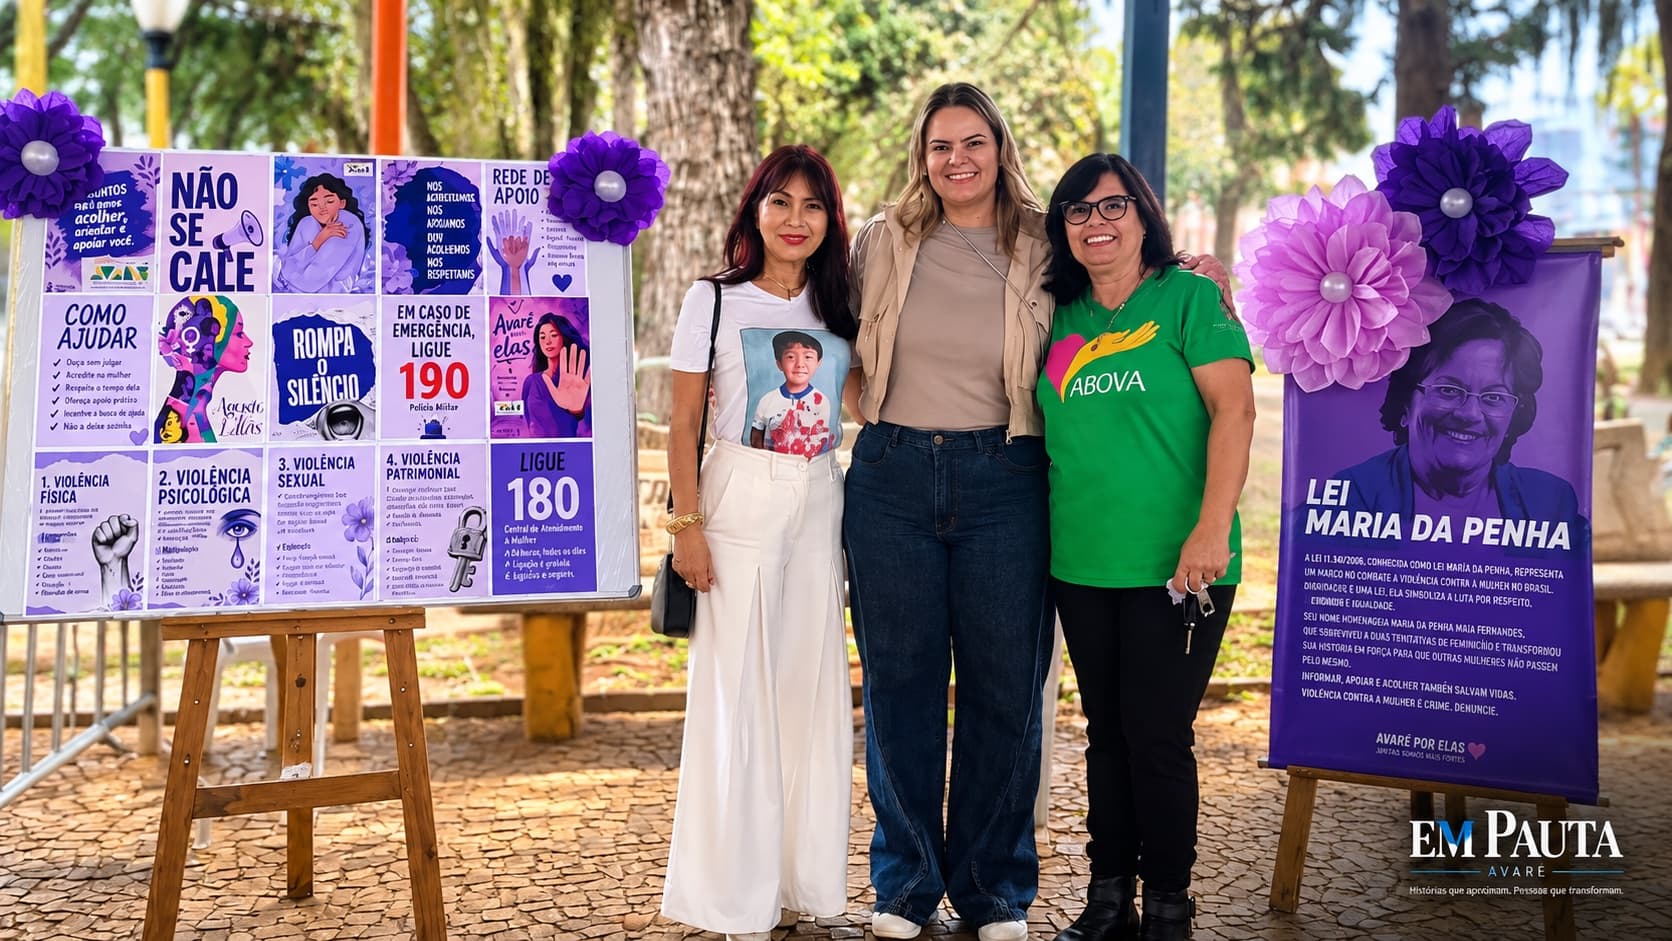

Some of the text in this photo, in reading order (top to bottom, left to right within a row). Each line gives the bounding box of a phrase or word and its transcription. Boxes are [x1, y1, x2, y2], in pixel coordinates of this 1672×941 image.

[427, 181, 443, 192] NOS
[493, 168, 550, 185] REDE DE
[171, 166, 238, 209] NÃO
[494, 187, 539, 205] APOIO
[427, 205, 443, 215] NOS
[169, 212, 204, 247] SE
[169, 250, 254, 292] CALE
[65, 303, 126, 325] COMO
[397, 305, 471, 320] EM CASO DE
[57, 327, 137, 349] AJUDAR
[392, 320, 475, 342] EMERGÊNCIA,
[293, 328, 355, 359] ROMPA
[411, 342, 451, 357] LIGUE
[494, 335, 531, 359] elas
[317, 358, 328, 375] O
[287, 374, 359, 406] SILÊNCIO
[399, 361, 470, 400] 190
[1069, 370, 1146, 398] ABOVA
[278, 454, 355, 471] 3. VIOLÊNCIA
[386, 450, 460, 466] 4. VIOLÊNCIA
[520, 452, 565, 472] LIGUE
[41, 472, 110, 488] 1. VIOLÊNCIA
[159, 465, 251, 486] 2. VIOLÊNCIA
[278, 473, 325, 488] SEXUAL
[386, 467, 460, 480] PATRIMONIAL
[40, 488, 77, 504] FÍSICA
[158, 483, 251, 505] PSICOLÓGICA
[507, 476, 579, 520] 180
[1306, 478, 1351, 506] LEI
[1304, 508, 1571, 550] MARIA DA PENHA
[1304, 553, 1310, 562] A
[1311, 554, 1322, 562] LEI
[1472, 564, 1483, 574] DA
[1304, 567, 1316, 577] UM
[1393, 574, 1398, 583] A
[1472, 579, 1477, 588] A
[1389, 588, 1403, 597] ELA
[1447, 592, 1452, 601] A
[1454, 593, 1474, 603] LUTA
[1475, 594, 1491, 605] POR
[1303, 612, 1317, 621] SEU
[1319, 613, 1340, 623] NOME
[1391, 618, 1414, 629] MARIA
[1417, 620, 1427, 630] DA
[1455, 624, 1476, 634] MAIA
[1303, 626, 1317, 636] QUE
[1364, 631, 1369, 640] A
[1438, 638, 1448, 647] DE
[1495, 642, 1500, 652] E
[1302, 641, 1317, 650] SUA
[1393, 648, 1413, 659] PARA
[1414, 650, 1430, 661] QUE
[1432, 652, 1462, 663] OUTRAS
[1302, 655, 1320, 665] PELO
[1345, 675, 1374, 687] APOIAR
[1376, 678, 1381, 687] E
[1382, 679, 1418, 691] ACOLHER
[1454, 685, 1487, 697] SALVAM
[1343, 692, 1374, 703] CONTRA
[1375, 695, 1381, 704] A
[1382, 696, 1416, 708] MULHER
[1376, 732, 1465, 753] AVARÉ POR ELAS
